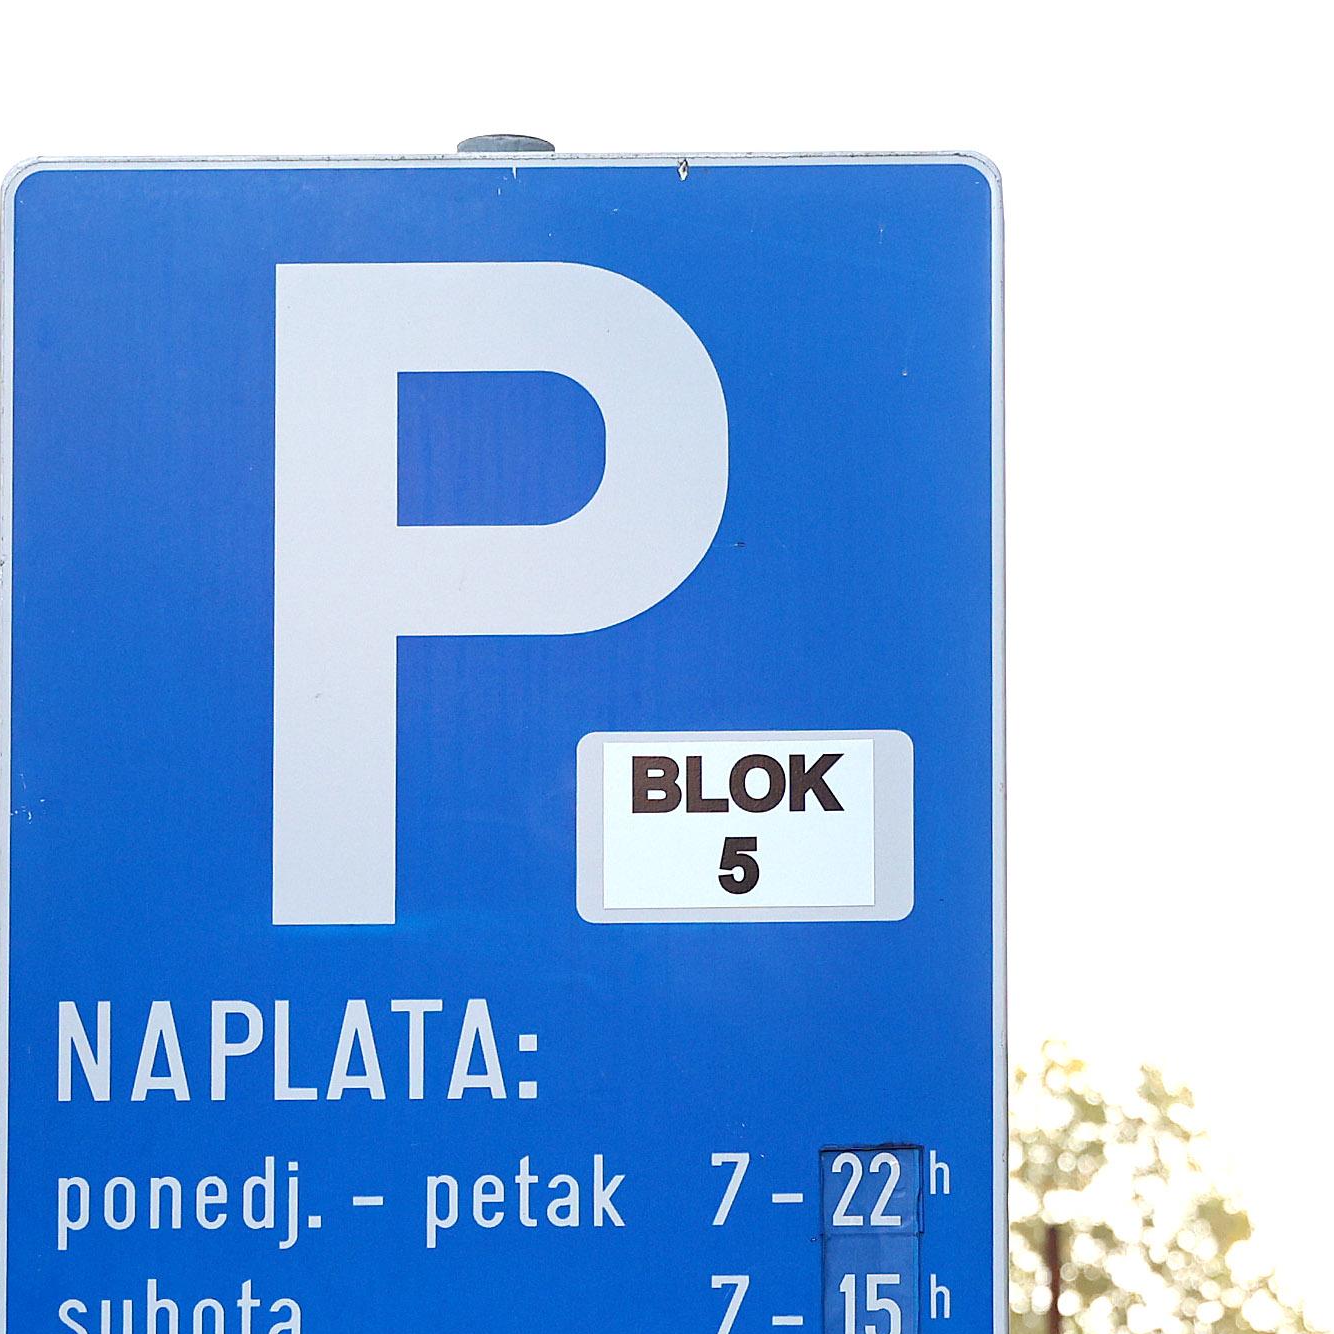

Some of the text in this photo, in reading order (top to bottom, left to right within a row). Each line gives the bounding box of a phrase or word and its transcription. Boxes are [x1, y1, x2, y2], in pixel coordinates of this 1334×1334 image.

[273, 262, 729, 925] P
[632, 754, 844, 813] BLOK
[719, 837, 759, 894] 5
[58, 999, 537, 1101] NAPLATA:
[58, 1156, 321, 1250] ponedj.
[427, 1155, 624, 1248] petak
[712, 1153, 749, 1225] 7
[832, 1153, 901, 1225] 22
